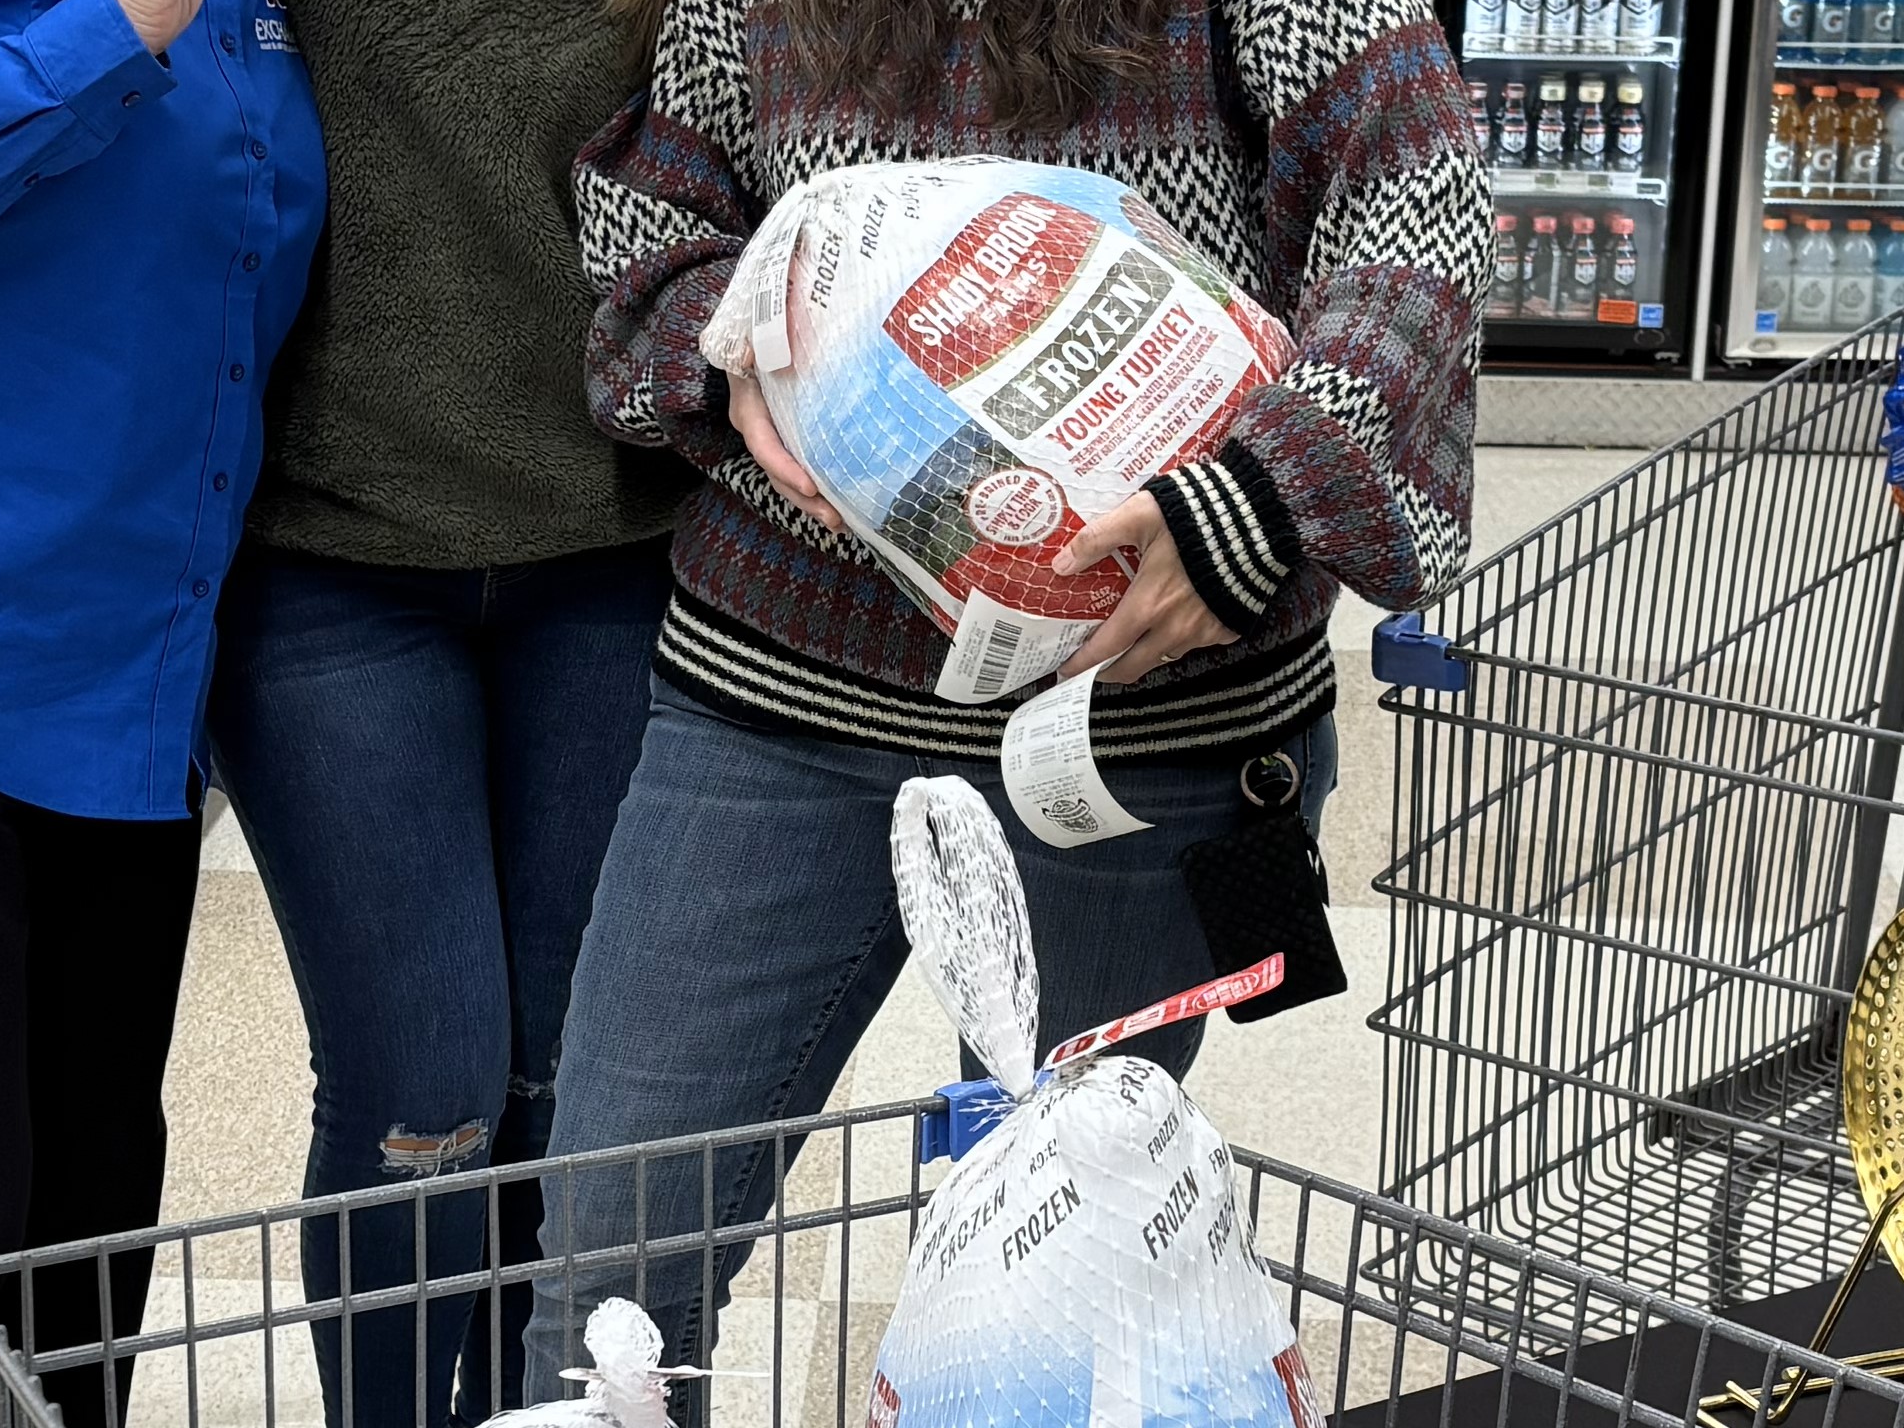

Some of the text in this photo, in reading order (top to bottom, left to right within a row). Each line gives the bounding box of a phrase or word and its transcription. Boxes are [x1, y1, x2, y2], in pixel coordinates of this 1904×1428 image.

[810, 228, 845, 309] FROZEN
[860, 193, 889, 259] FROZEN
[907, 200, 1057, 346] SHADY BROOK
[981, 249, 1048, 327] FARMS
[1017, 273, 1152, 412] FROZEN
[1046, 299, 1195, 452] YOUNG TURKEY
[1121, 373, 1225, 482] INDEPENDENT FARMS
[986, 476, 1041, 535] SIMPLY THAW
[1147, 1112, 1181, 1162] FROZEN
[1003, 1179, 1082, 1272] FROZEN
[1143, 1164, 1200, 1261] FROZEN
